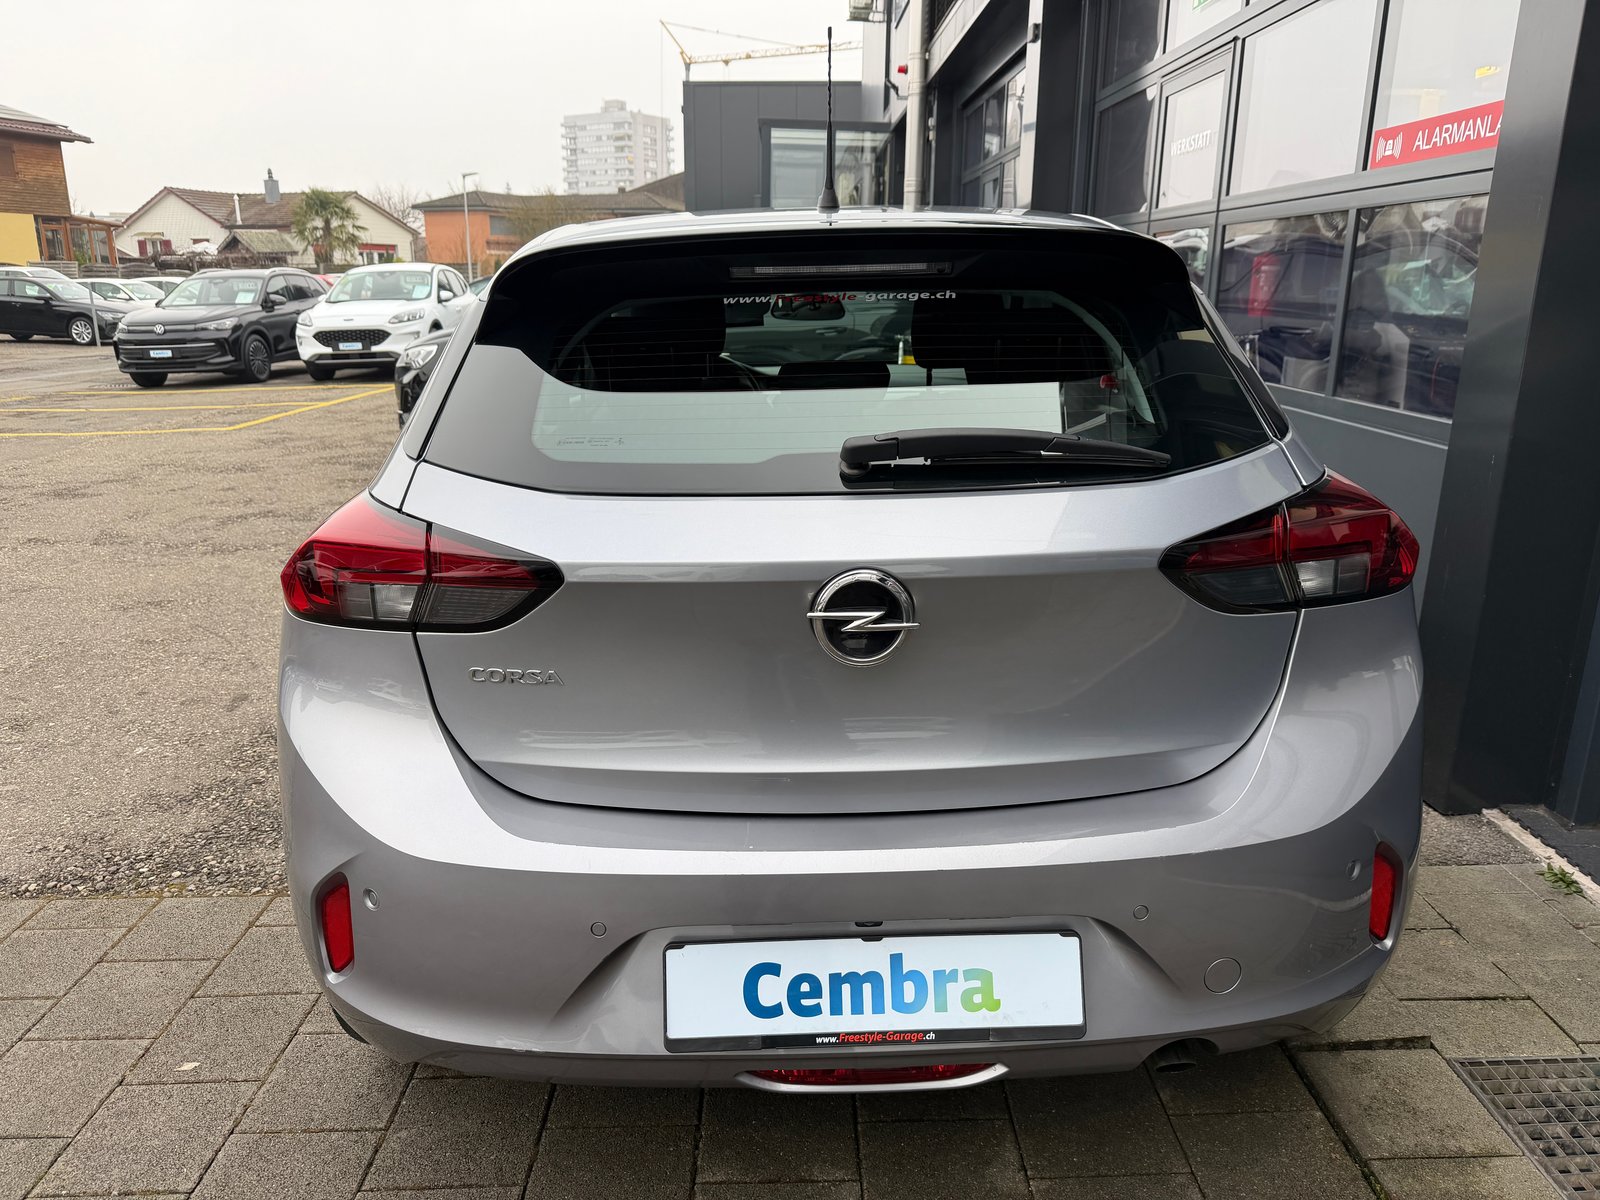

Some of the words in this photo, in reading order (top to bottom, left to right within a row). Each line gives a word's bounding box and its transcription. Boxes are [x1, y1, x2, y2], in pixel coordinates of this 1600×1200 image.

[1170, 130, 1212, 156] WERKSTATT
[468, 667, 564, 686] CORSA
[742, 952, 1001, 1019] Cembra
[815, 1031, 936, 1044] www.Freestyle-Garage.ch
